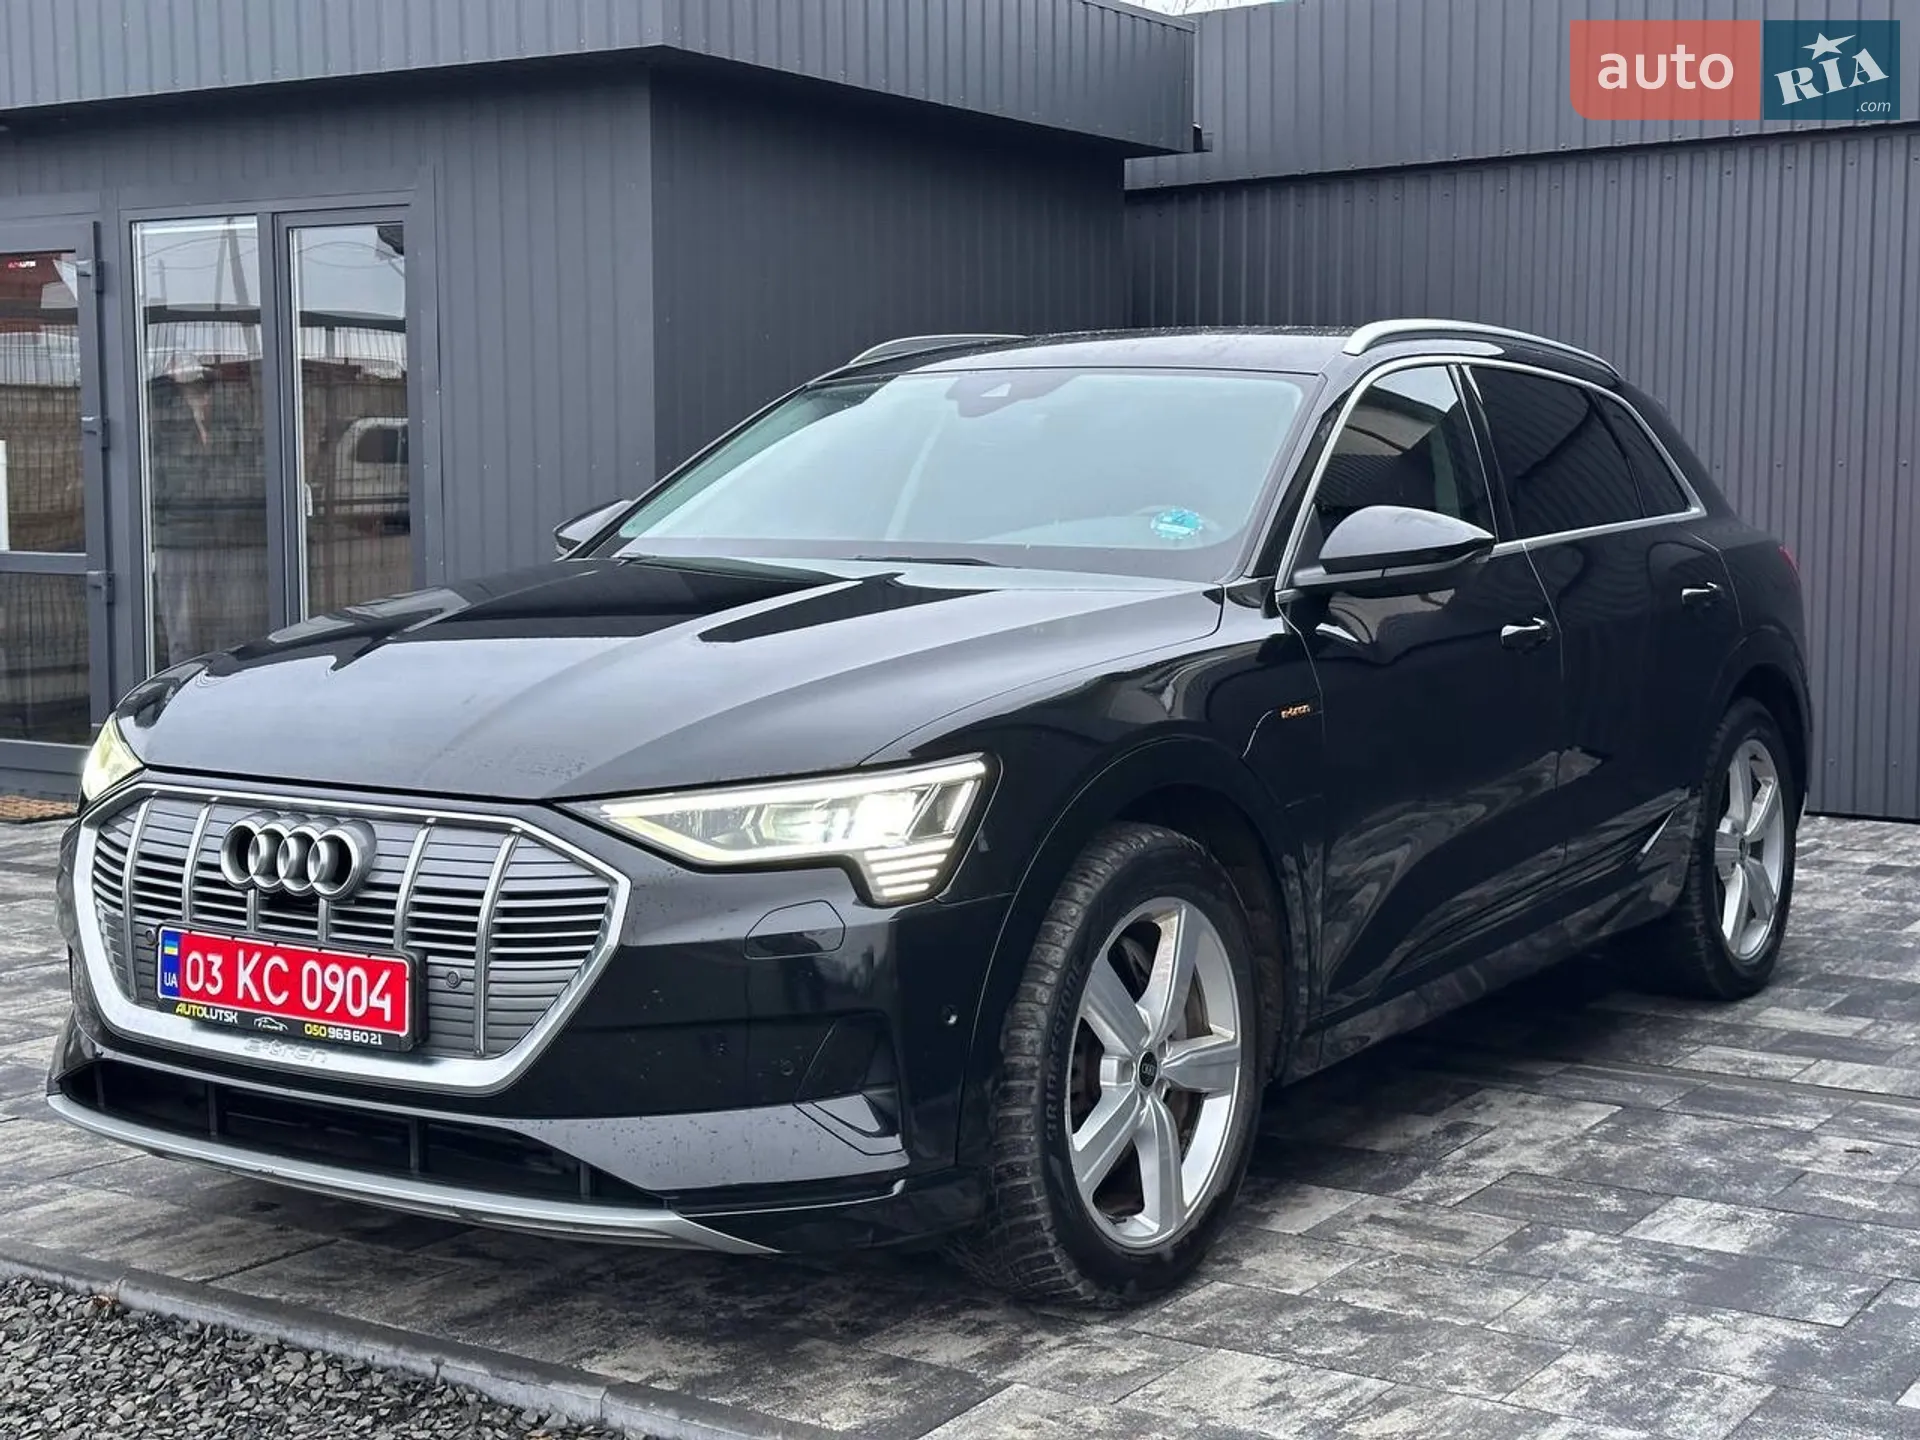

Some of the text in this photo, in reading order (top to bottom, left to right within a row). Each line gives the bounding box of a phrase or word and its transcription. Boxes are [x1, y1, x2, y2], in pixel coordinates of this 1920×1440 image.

[163, 971, 179, 989] UA
[185, 949, 392, 1022] 03 KC 0904
[175, 1002, 239, 1024] AUTOLUTSK
